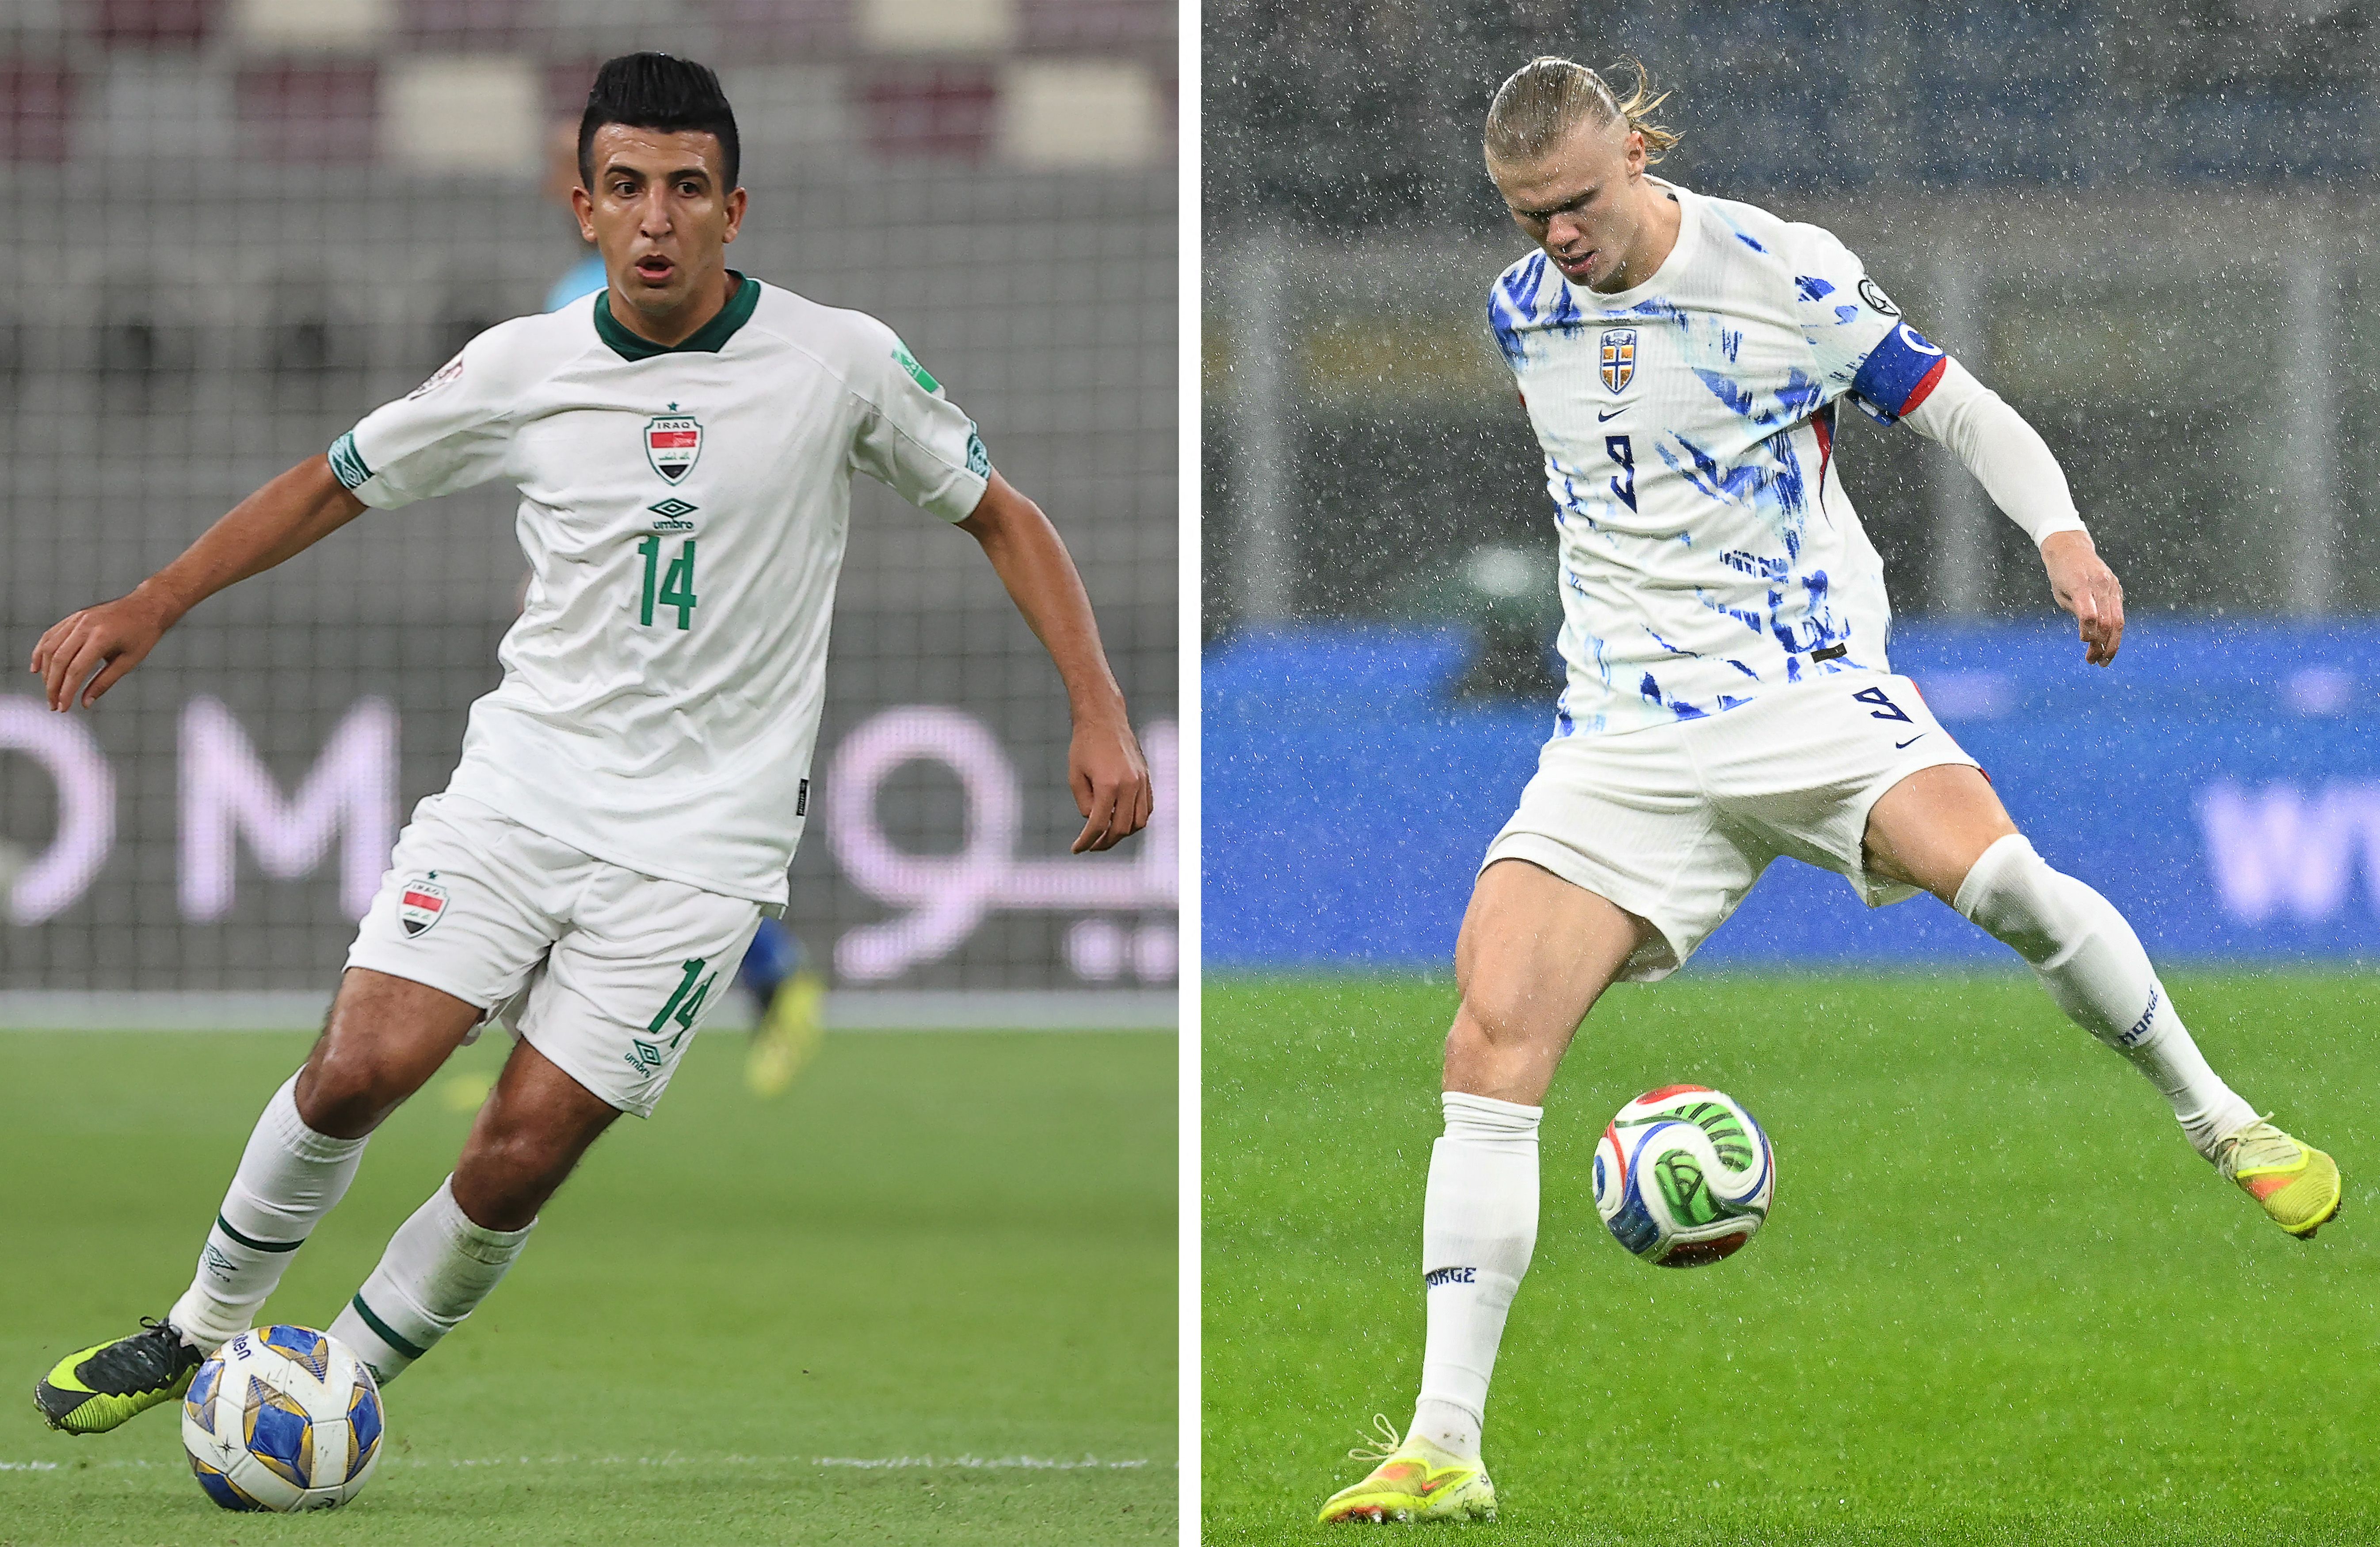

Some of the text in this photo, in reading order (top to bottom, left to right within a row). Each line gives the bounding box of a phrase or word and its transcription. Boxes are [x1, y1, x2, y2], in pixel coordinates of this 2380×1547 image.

[1605, 435, 1637, 514] 9
[653, 519, 694, 529] umbro
[638, 535, 697, 630] 14
[1852, 686, 1914, 724] 9
[648, 957, 718, 1049] 14
